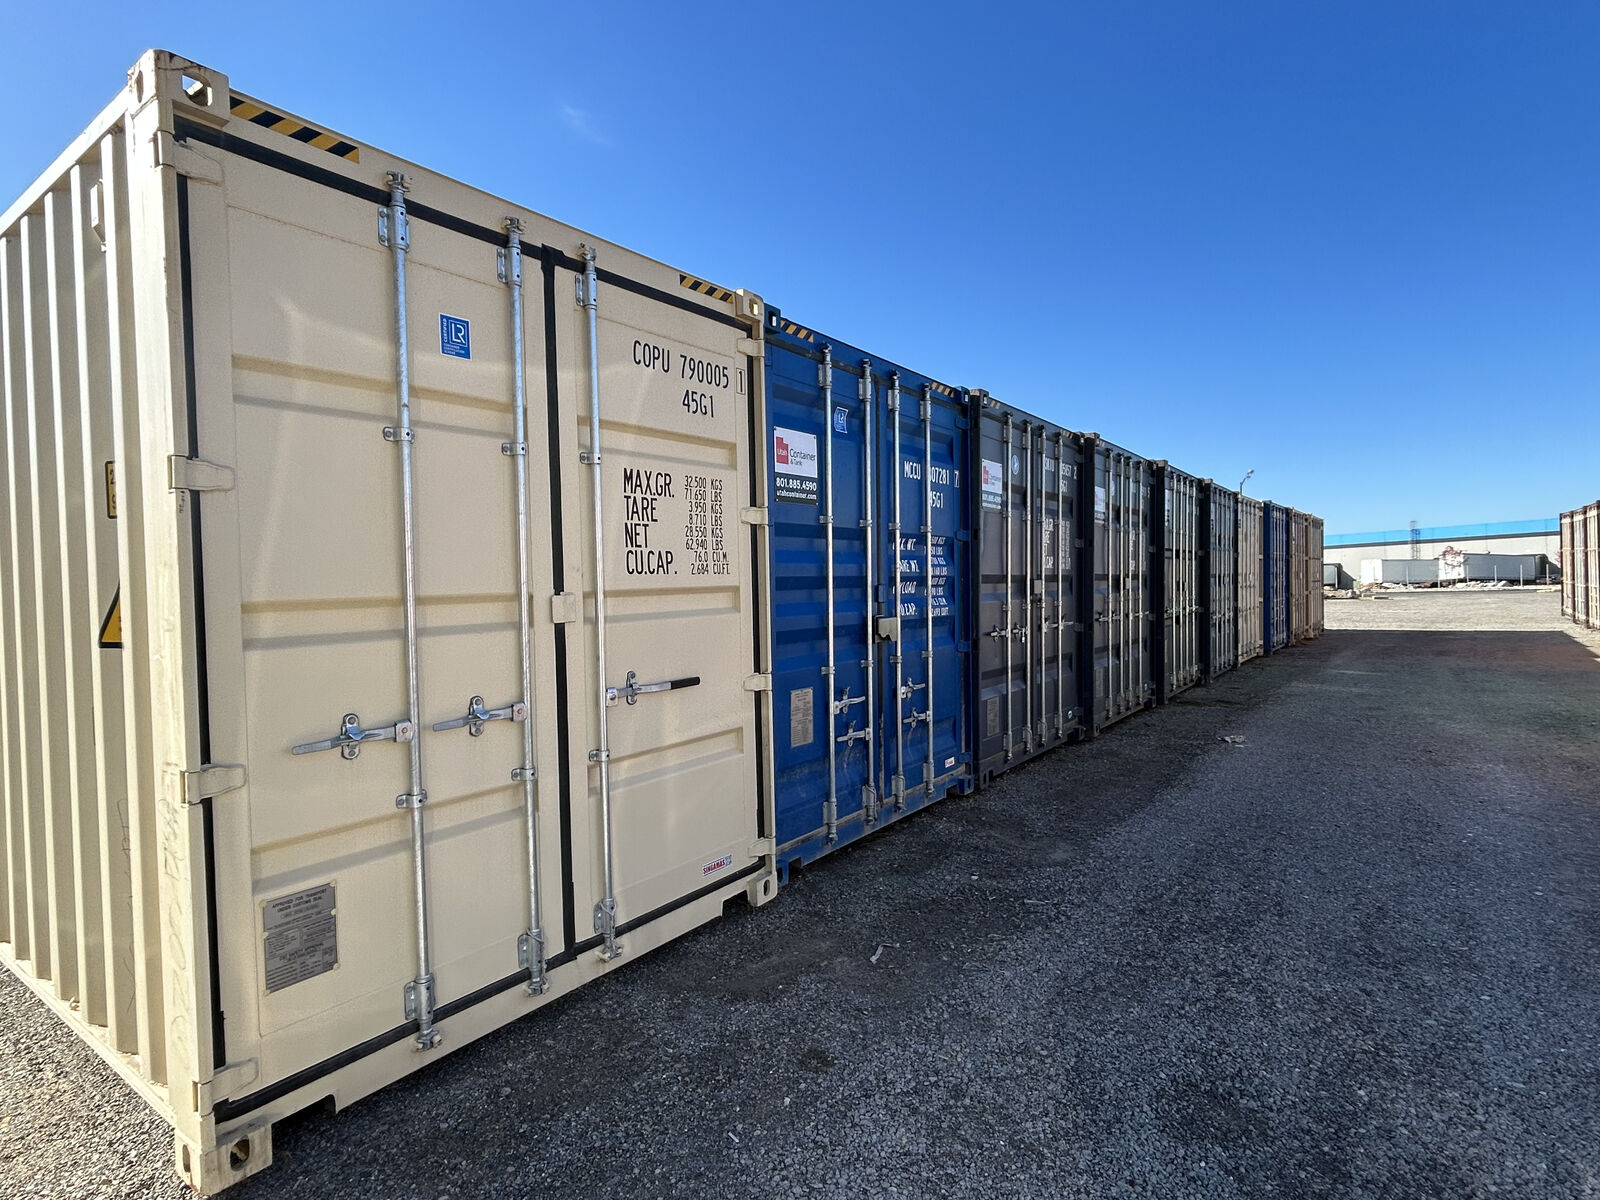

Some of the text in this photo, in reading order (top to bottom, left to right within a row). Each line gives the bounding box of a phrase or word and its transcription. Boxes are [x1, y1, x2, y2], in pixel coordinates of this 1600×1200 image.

[633, 339, 670, 373] COPU
[680, 353, 729, 390] 790005
[682, 389, 714, 419] 45G1
[790, 448, 816, 462] Container
[623, 467, 723, 498] MAX.GR. 32.500 KGS
[776, 477, 817, 491] 801.885.4590
[685, 488, 723, 503] 71.650 LBS
[623, 495, 723, 523] TARE 3.950 KGS
[688, 513, 723, 527] 8.710 LBS
[624, 522, 723, 549] NET 28.550 KGS
[685, 538, 724, 551] 62.940 LBS
[693, 551, 709, 563] 76.0
[690, 563, 709, 575] 2.684
